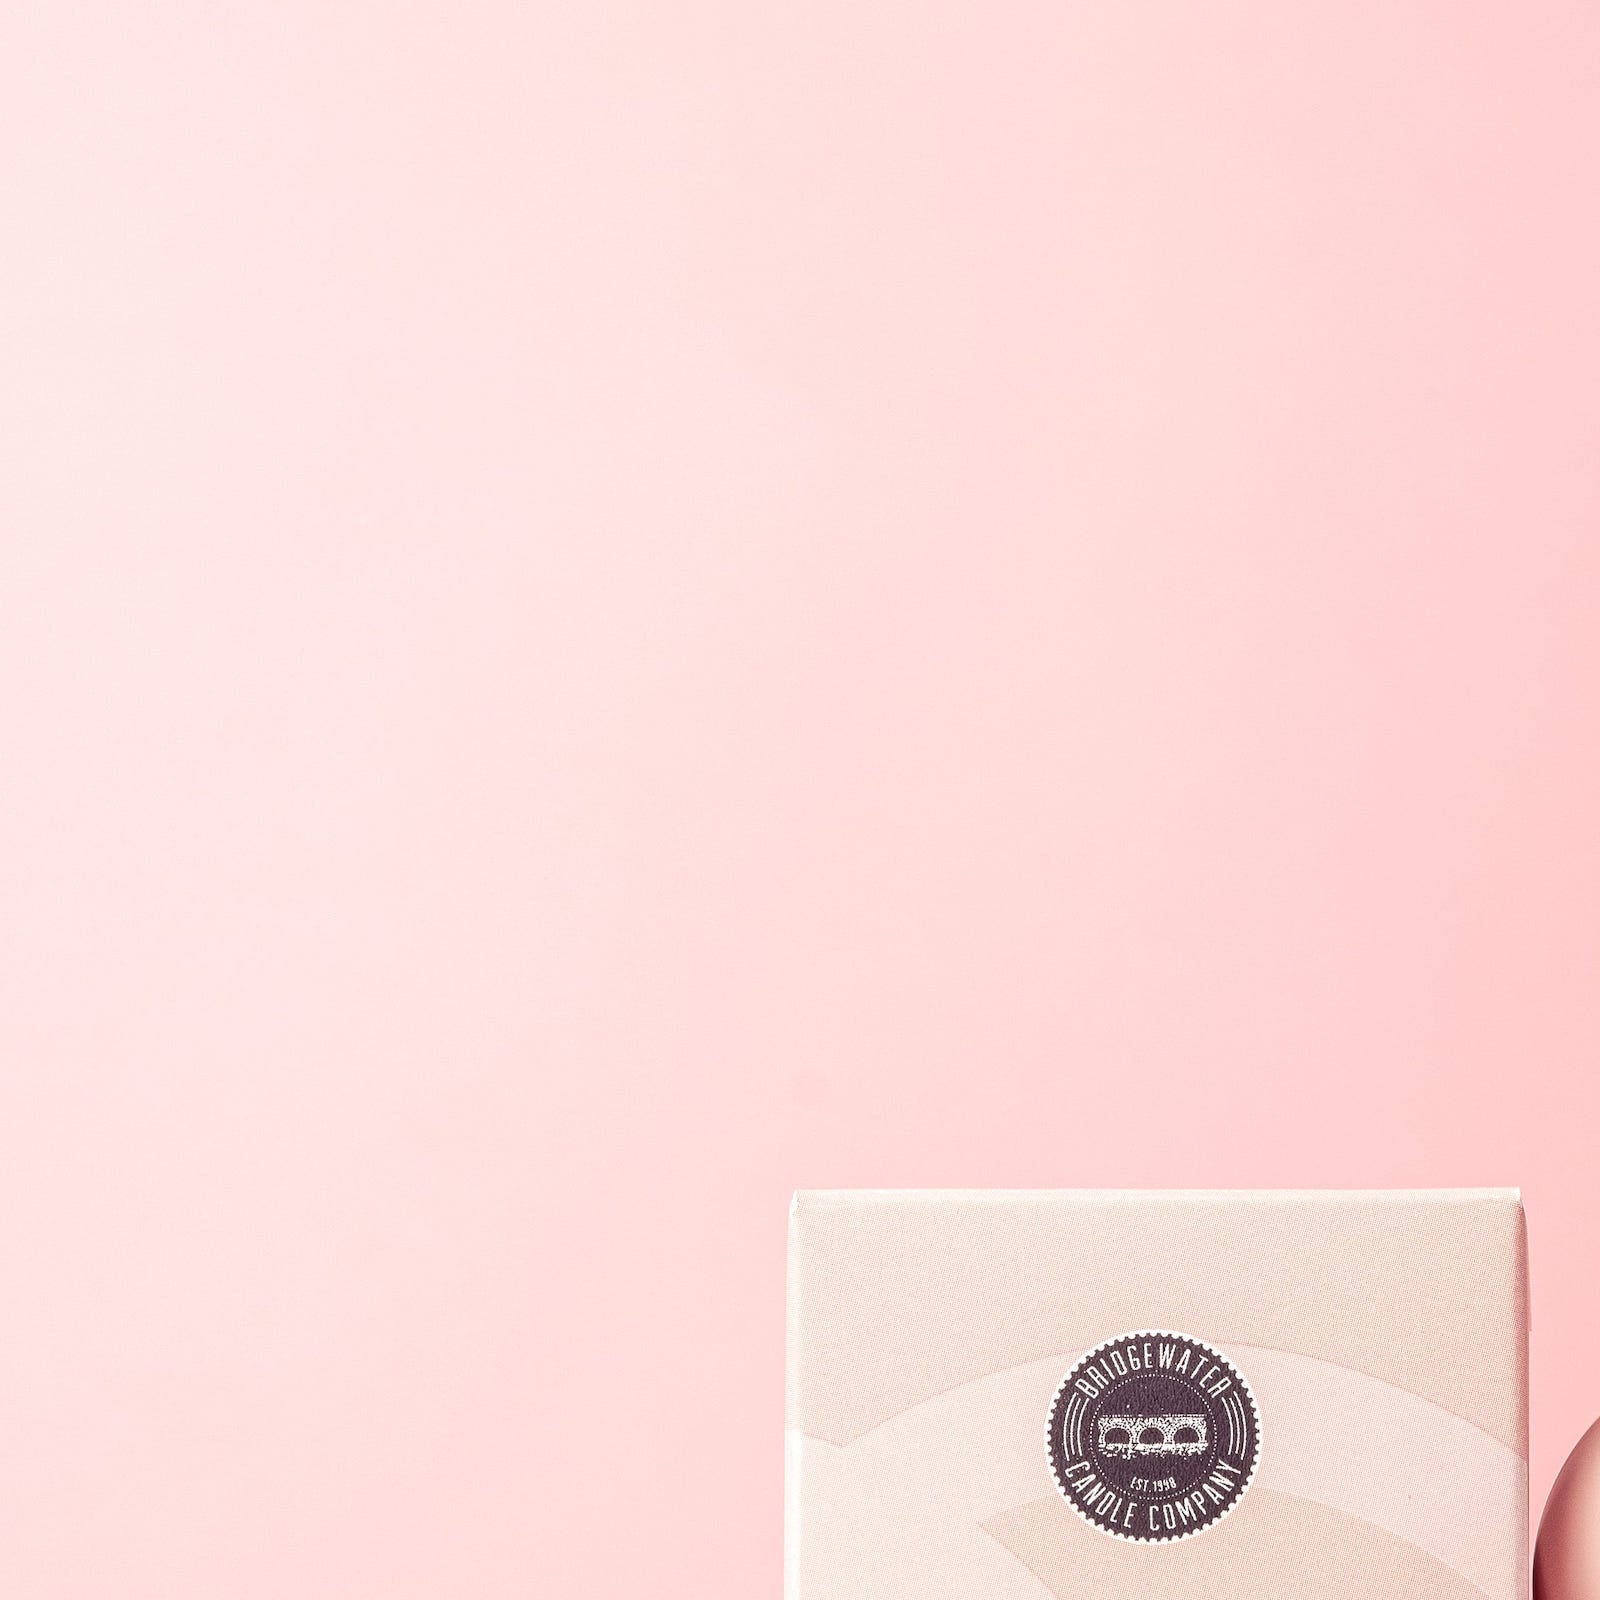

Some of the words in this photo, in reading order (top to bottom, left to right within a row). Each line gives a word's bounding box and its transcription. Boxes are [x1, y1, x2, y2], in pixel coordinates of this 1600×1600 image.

[1075, 1343, 1232, 1399] BRIDGEWATER
[1065, 1461, 1138, 1528] CANDLE
[1149, 1459, 1242, 1531] COMPANY
